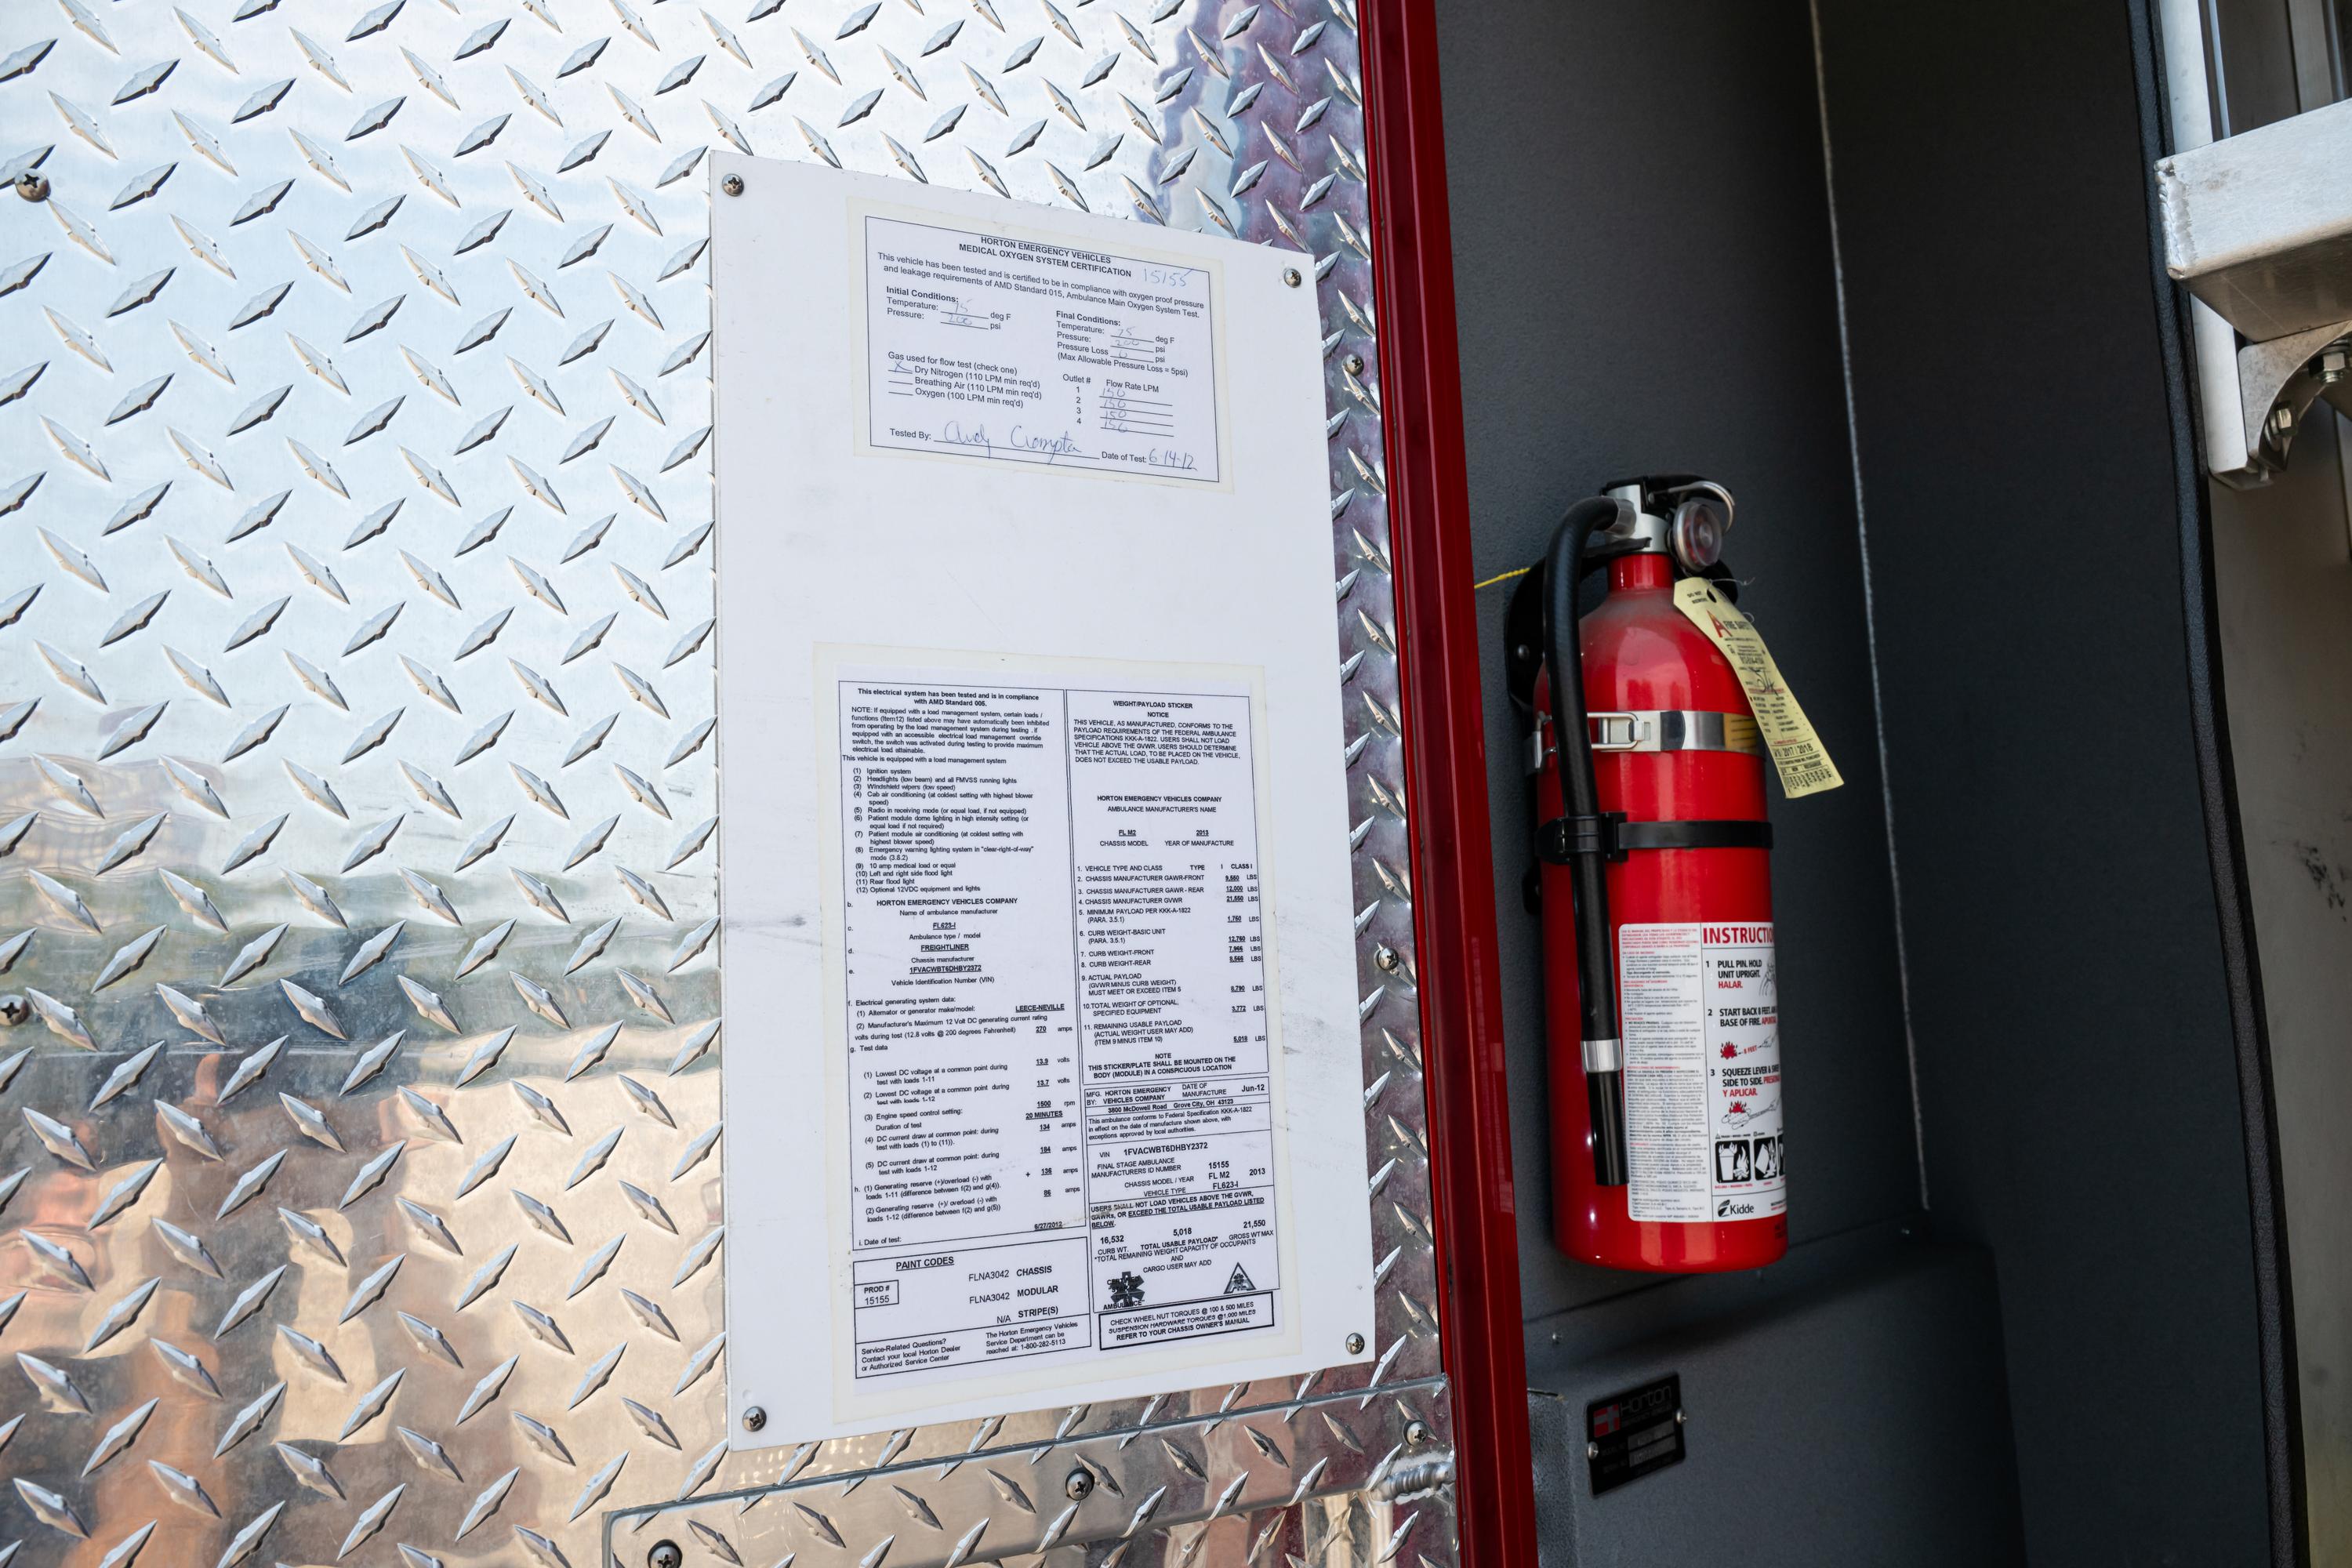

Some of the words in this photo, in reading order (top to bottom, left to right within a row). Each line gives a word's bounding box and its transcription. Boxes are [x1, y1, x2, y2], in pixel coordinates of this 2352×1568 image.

[981, 236, 1016, 249] HORTON
[1018, 242, 1069, 257] EMERGENCY
[1071, 251, 1111, 264] VEHICLES
[959, 243, 997, 256] MEDICAL
[999, 250, 1033, 262] OXYGEN
[1036, 256, 1069, 267] SYSTEM
[1070, 261, 1131, 278] CERTIFICATION
[877, 252, 895, 262] This
[896, 256, 924, 266] vehicle
[925, 260, 940, 268] has
[942, 262, 961, 271] been
[963, 266, 986, 275] tested
[1012, 274, 1040, 284] certified
[1051, 278, 1061, 287] be
[1070, 283, 1111, 295] compliance
[1112, 289, 1127, 297] with
[1128, 292, 1153, 301] oxygen
[1174, 299, 1204, 309] pressure
[887, 285, 909, 296] Initial
[911, 289, 959, 303] Conditions:
[900, 267, 931, 278] leakage
[933, 273, 983, 285] requirements
[993, 281, 1012, 289] AMD
[1014, 283, 1047, 295] Standard
[1048, 289, 1065, 299] 015,
[1066, 292, 1106, 304] Ambulance
[1108, 298, 1126, 307] Main
[1127, 300, 1154, 311] Oxygen
[1156, 305, 1181, 315] System
[1182, 309, 1200, 318] Test.
[887, 296, 938, 310] Temperature:
[990, 311, 1004, 321] deg
[887, 307, 924, 319] Pressure:
[1056, 310, 1075, 320] Final
[1076, 314, 1120, 326] Conditions:
[914, 365, 929, 376] Dry
[931, 368, 964, 379] Nitrogen
[965, 372, 983, 381] (110
[985, 374, 1002, 383] LPM
[1019, 380, 1040, 390] req'd)
[890, 428, 916, 438] Tested
[919, 431, 931, 441] By:
[1102, 451, 1119, 460] Date
[1129, 454, 1147, 463] Test:
[1797, 743, 1813, 754] 2018
[1736, 970, 1761, 978] UPRIGHT.
[1743, 1007, 1758, 1016] BACK
[1720, 1018, 1738, 1027] BASE
[1739, 1018, 1748, 1026] OF
[1722, 1067, 1751, 1077] SQUEEZE
[1753, 1066, 1767, 1075] LEVER
[1241, 1083, 1265, 1092] Jun-12
[1722, 1078, 1739, 1087] SIDE
[1730, 1087, 1758, 1097] APLICAR.
[1123, 1142, 1208, 1156] 1FVACWBT6DHBY2372
[1208, 1160, 1229, 1169] 15155
[1249, 1167, 1265, 1176] 2013
[1730, 1203, 1754, 1214] Kidde
[1243, 1219, 1266, 1229] 21,550
[1173, 1227, 1192, 1236] 5,018
[1100, 1235, 1124, 1244] 16,532
[896, 1259, 924, 1271] PAINT
[923, 1256, 954, 1269] CODES
[968, 1269, 1009, 1282] FLNA3042
[1016, 1265, 1052, 1276] CHASSIS
[865, 1294, 890, 1305] 15155
[969, 1292, 1010, 1304] FLNA3042
[1017, 1285, 1058, 1297] MODULAR
[996, 1315, 1011, 1323] N/A
[1018, 1306, 1058, 1318] STRIPE(S)
[1020, 1326, 1052, 1334] Emergency
[1116, 1332, 1138, 1341] REFER
[1167, 1324, 1194, 1334] CHASSIS
[1196, 1320, 1223, 1330] OWNER'S
[1225, 1317, 1250, 1326] MANUAL
[1009, 1334, 1043, 1344] Department
[986, 1346, 1009, 1355] reached
[1021, 1338, 1066, 1350] 1-800-282-5113
